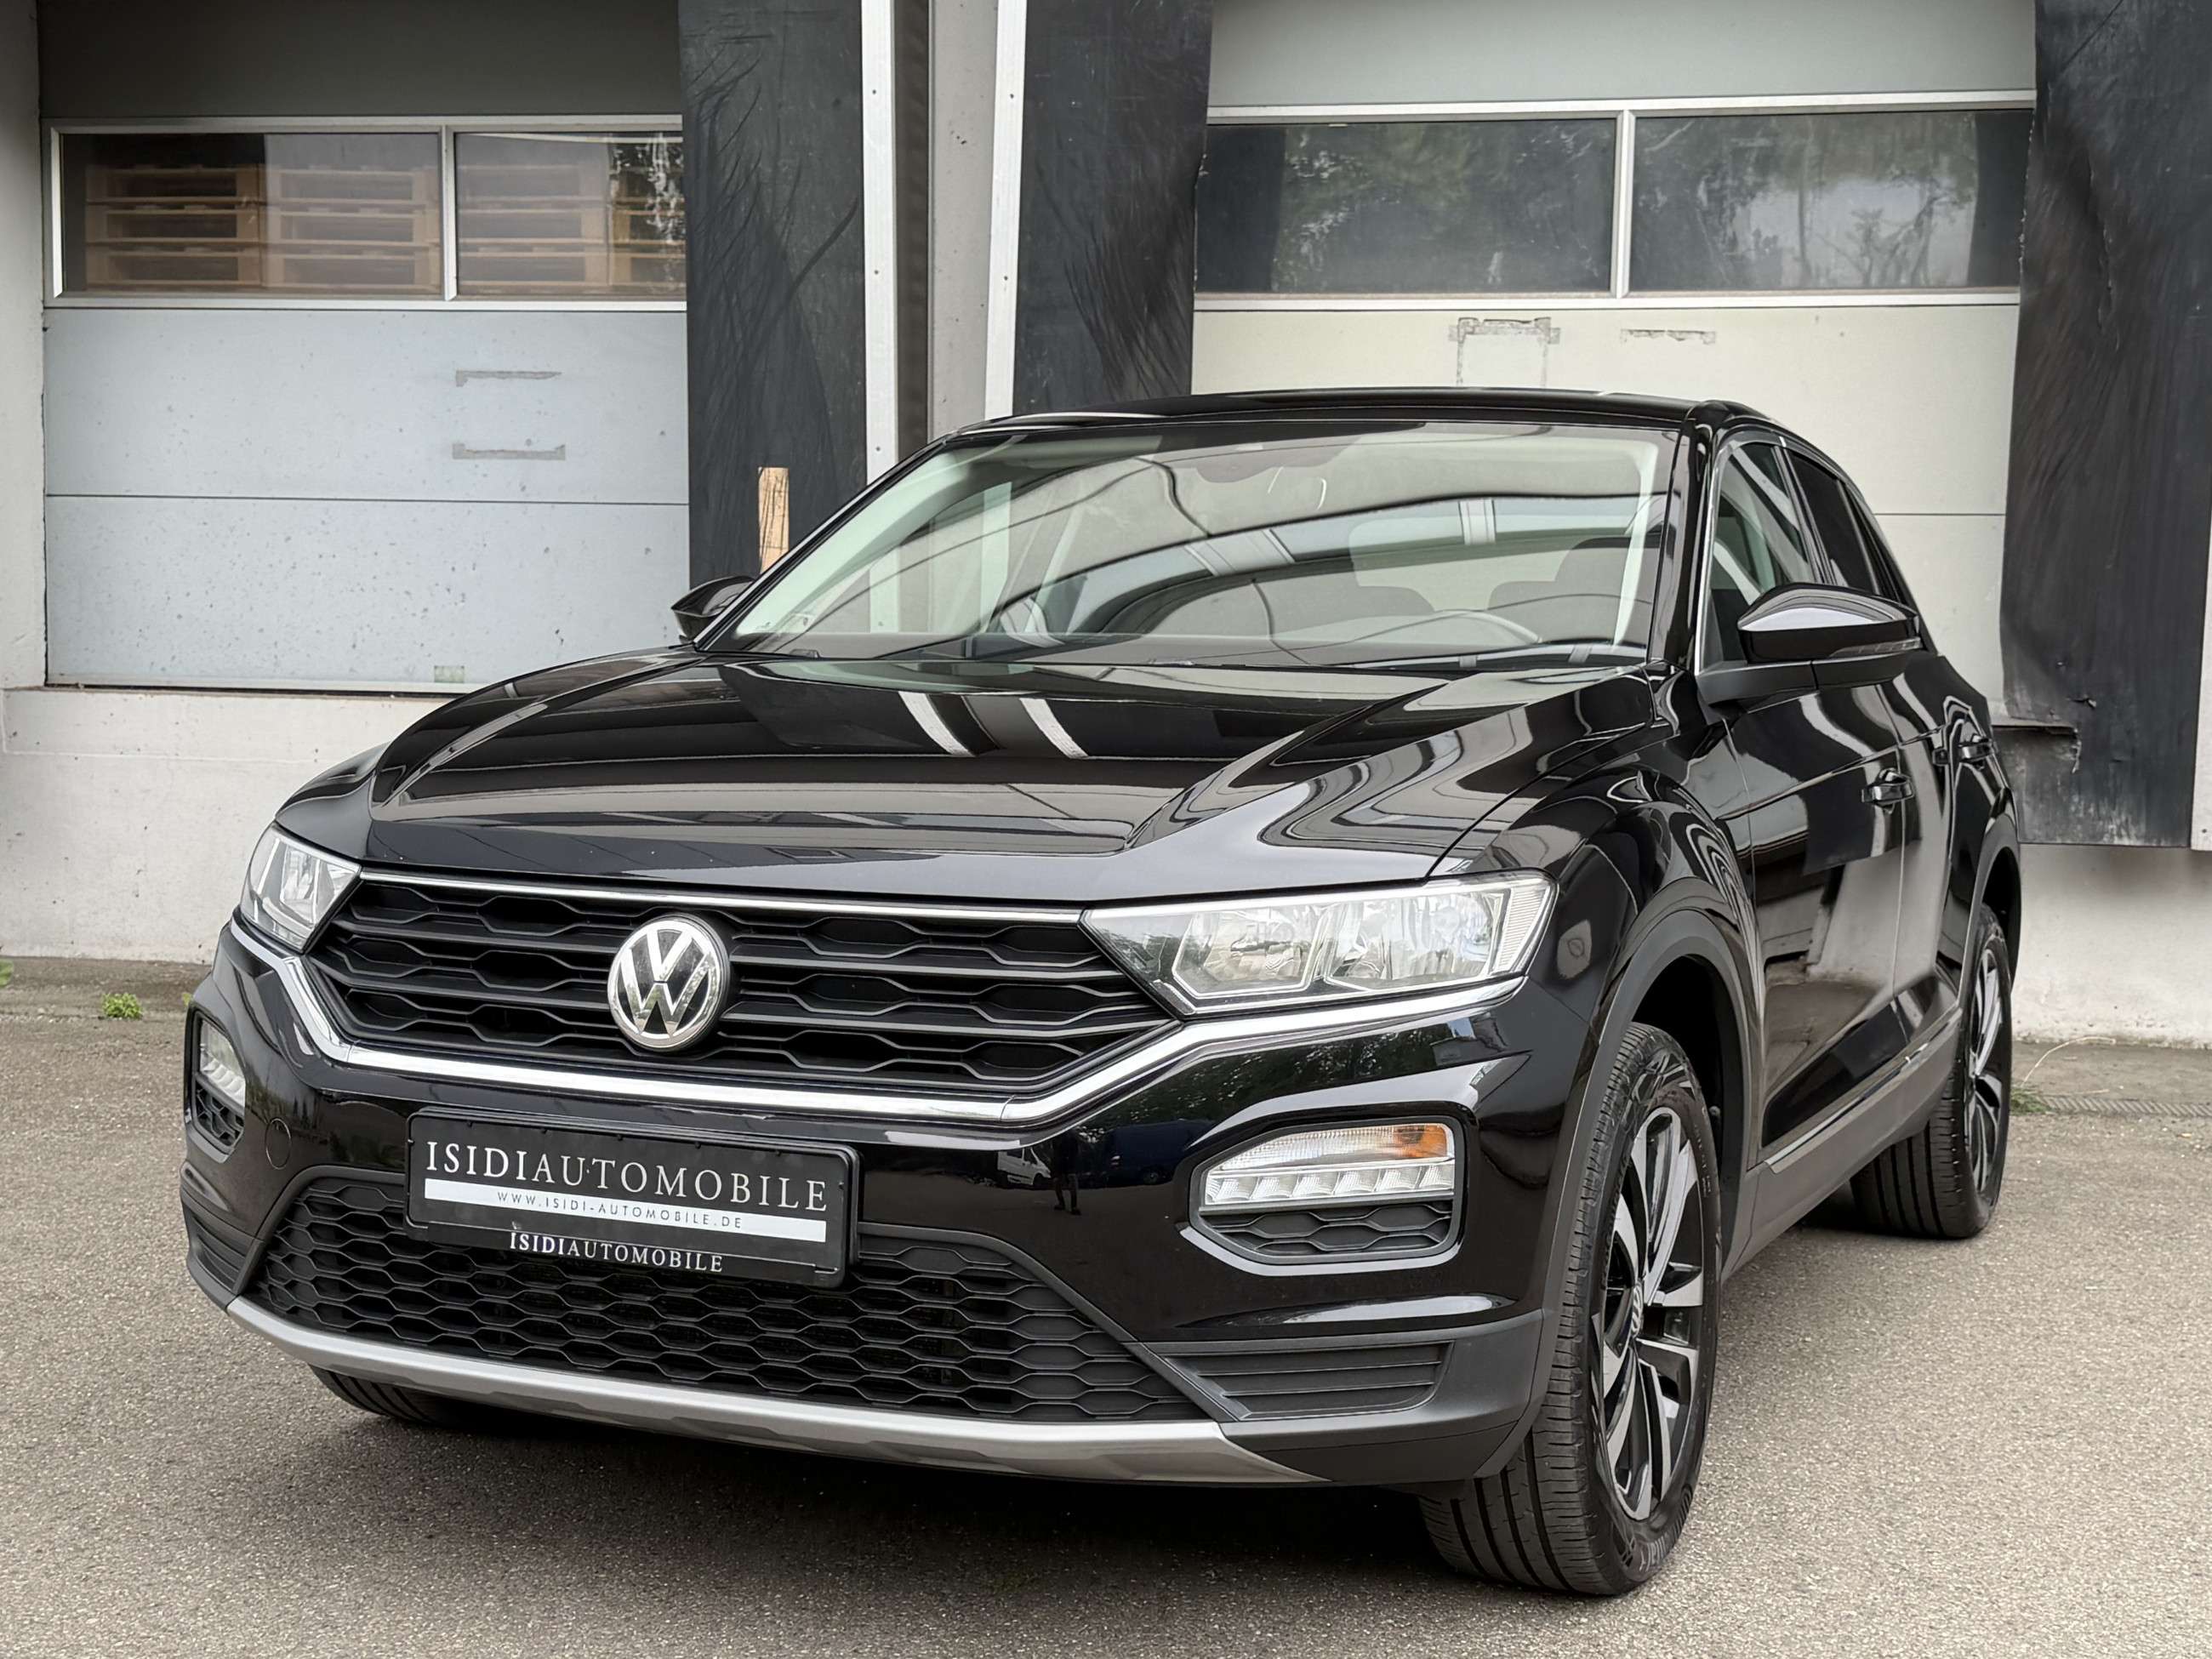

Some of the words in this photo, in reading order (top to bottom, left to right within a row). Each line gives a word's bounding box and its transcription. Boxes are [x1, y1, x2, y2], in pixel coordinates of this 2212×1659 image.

[613, 921, 720, 1045] VW
[426, 1141, 827, 1211] ISIDIAUTOMOBILE
[497, 1191, 743, 1229] WWW.ISIDI-AUTOMOBILE.DE
[510, 1232, 723, 1273] ISIDIAUTOMOBILE
